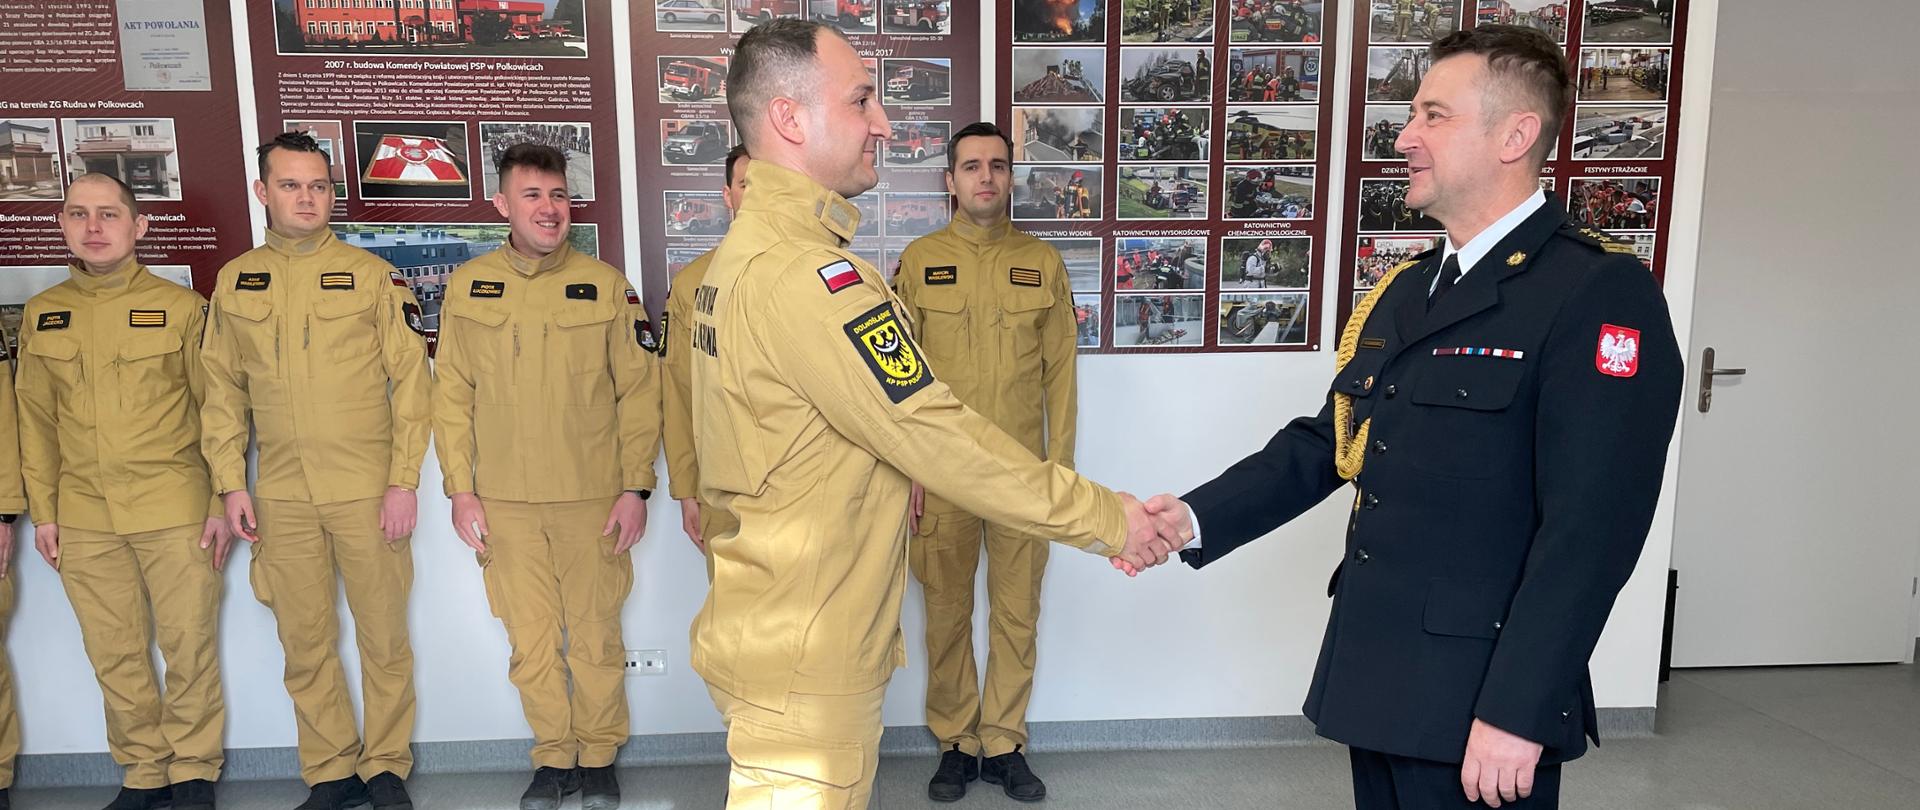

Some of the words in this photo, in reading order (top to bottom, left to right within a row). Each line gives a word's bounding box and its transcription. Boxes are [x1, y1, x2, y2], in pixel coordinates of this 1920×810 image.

[144, 21, 200, 29] POWOŁANIA
[386, 62, 422, 70] Komendy
[424, 62, 469, 71] Powiatowej
[33, 214, 56, 222] nowej
